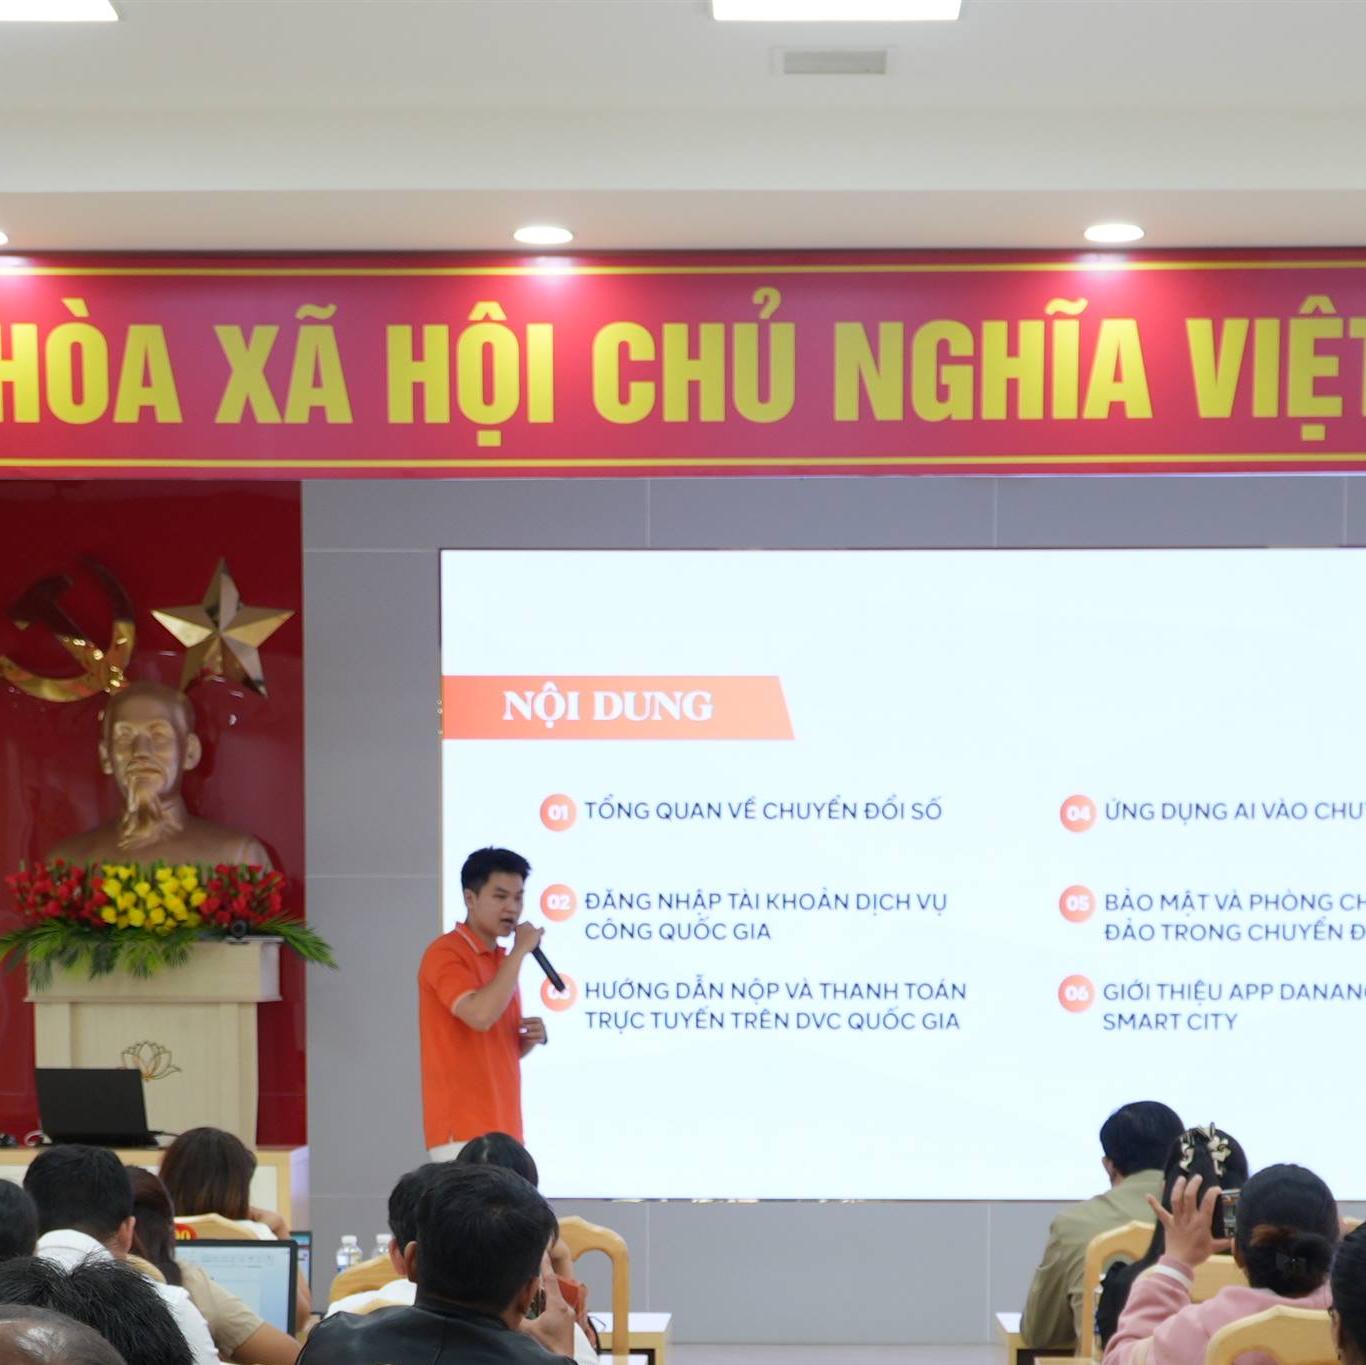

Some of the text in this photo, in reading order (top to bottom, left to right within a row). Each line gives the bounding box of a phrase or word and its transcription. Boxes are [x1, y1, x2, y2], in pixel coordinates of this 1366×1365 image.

[214, 303, 353, 424] XÃ
[386, 301, 555, 447] HỘI
[591, 288, 796, 424] CHỦ
[834, 297, 1153, 422] NGHĨA
[503, 682, 714, 728] NỘI DUNG
[548, 794, 942, 820] 01 TỔNG QUAN VỀ CHUYỂN ĐỔI SỐ
[1066, 805, 1091, 821] 04
[1105, 799, 1155, 820] ỨNG
[1162, 803, 1227, 825] DỤNG
[1235, 803, 1255, 819] AI
[1262, 800, 1307, 820] VÀO
[547, 888, 947, 916] 02 ĐĂNG NHẬP TÀI KHOẢN DỊCH VỤ
[1066, 896, 1090, 911] 05
[1105, 889, 1153, 911] BẢO
[1160, 890, 1208, 916] MẬT
[1215, 890, 1242, 910] VÀ
[1250, 889, 1333, 911] PHÒNG
[585, 917, 771, 941] CÔNG QUỐC GIA
[1104, 918, 1154, 941] ĐẢO
[1162, 924, 1241, 941] TRONG
[1248, 916, 1343, 941] CHUYỂN
[585, 978, 670, 1000] HƯỚNG
[677, 974, 723, 1000] DẪN
[731, 978, 779, 1005] NỘP
[786, 979, 813, 1000] VÀ
[819, 983, 898, 1000] THANH
[905, 979, 966, 1000] TOÁN
[1065, 987, 1089, 1001] 06
[1103, 979, 1150, 1000] GIỚI
[1157, 980, 1222, 1005] THIỆU
[1229, 984, 1274, 1000] APP
[585, 1007, 960, 1034] TRỰC TUYẾN TRÊN DVC QUỐC GIA
[1103, 1013, 1238, 1030] SMART CITY
